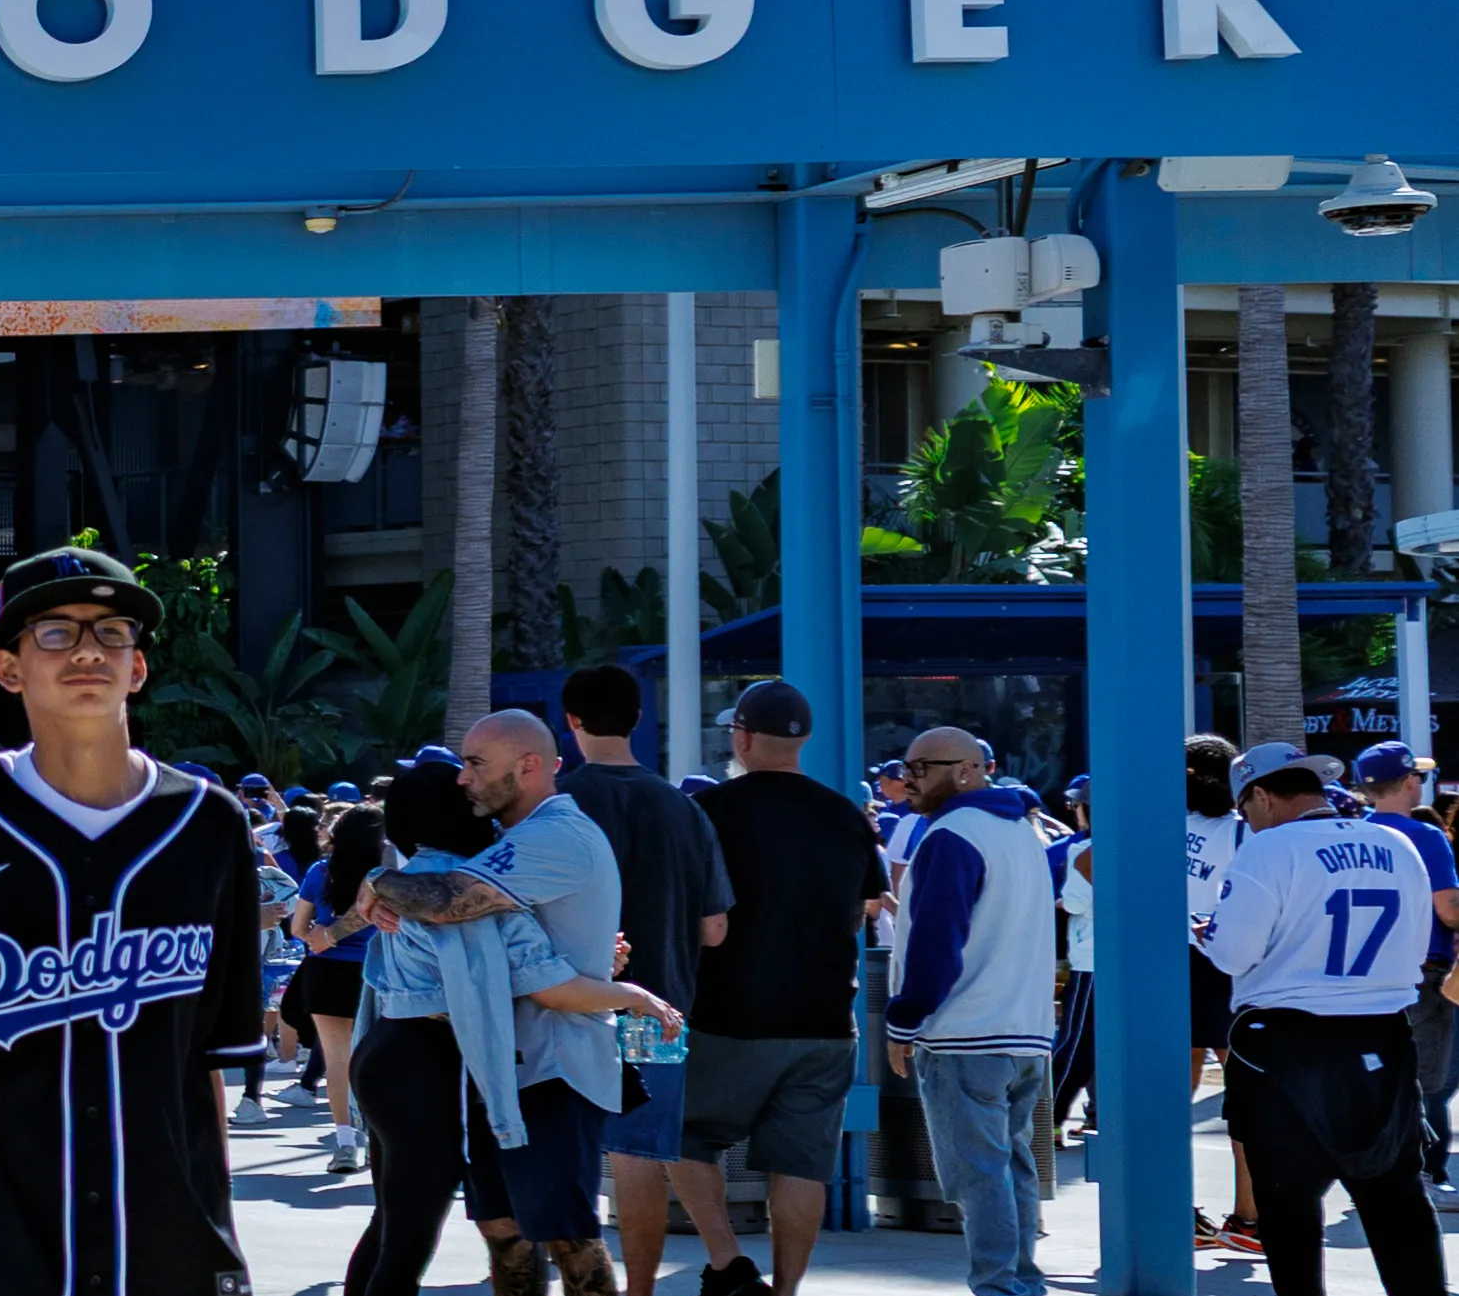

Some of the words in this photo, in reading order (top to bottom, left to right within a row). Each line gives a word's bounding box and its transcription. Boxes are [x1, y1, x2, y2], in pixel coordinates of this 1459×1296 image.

[1351, 708, 1440, 734] MEYS
[482, 842, 516, 875] LA
[1316, 842, 1394, 874] OHTANI
[1324, 888, 1401, 977] 17
